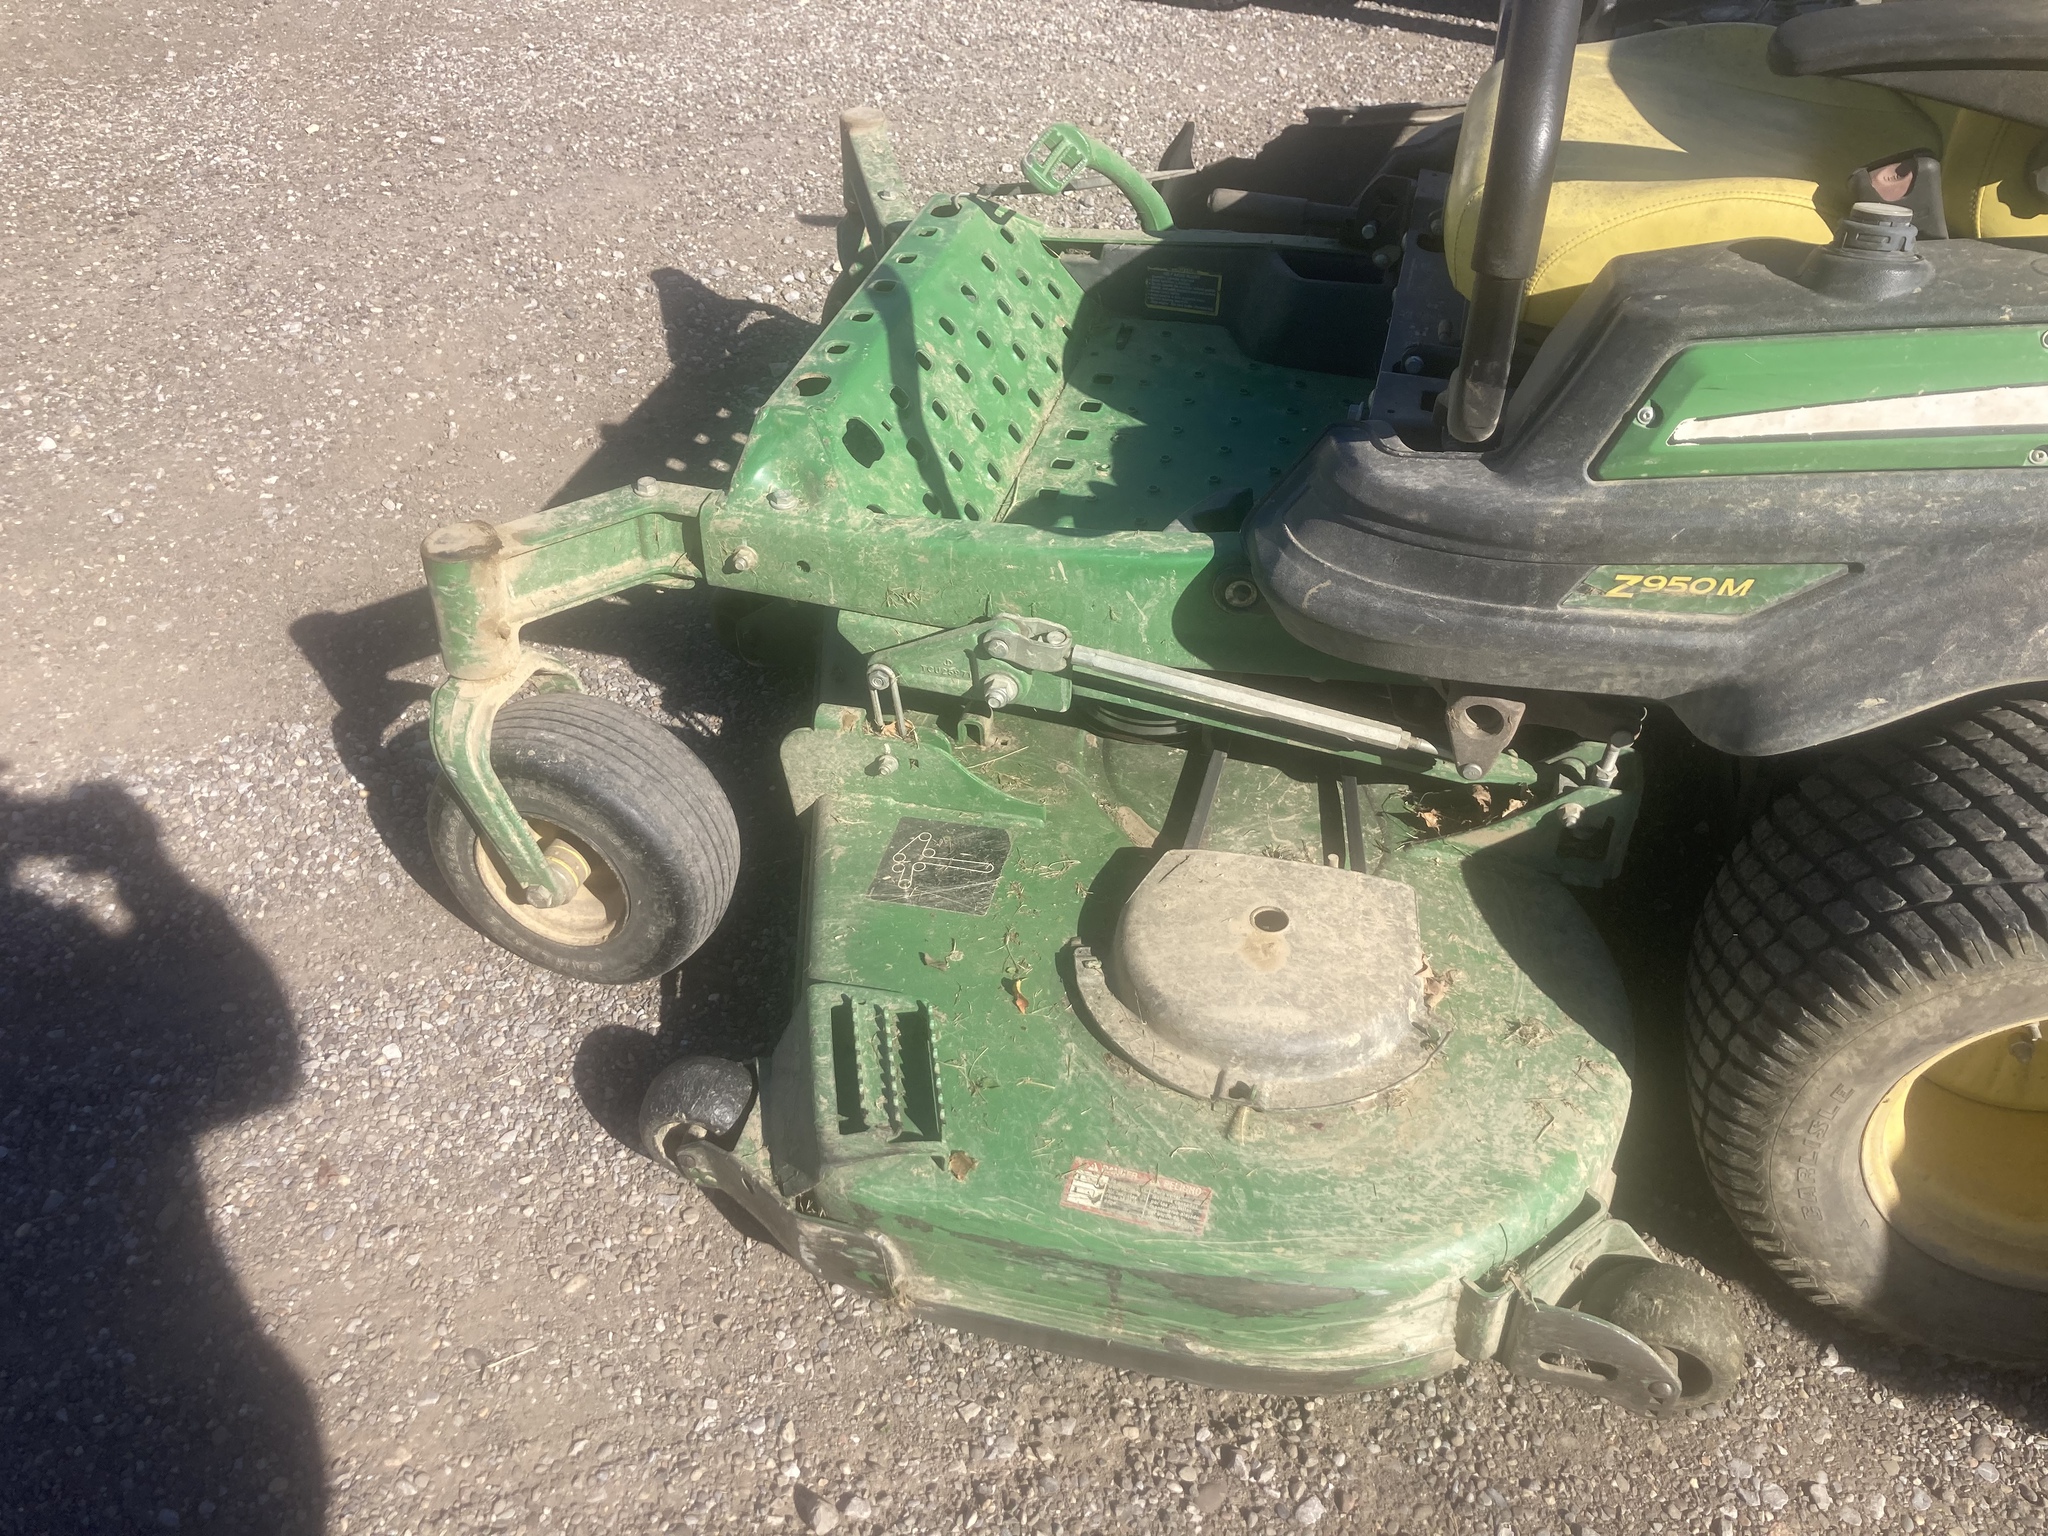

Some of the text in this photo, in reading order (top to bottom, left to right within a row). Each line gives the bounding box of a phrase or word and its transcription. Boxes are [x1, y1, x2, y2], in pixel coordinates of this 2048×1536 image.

[1604, 574, 1755, 598] Z950M
[1796, 1082, 1855, 1222] CARLISLE
[1164, 1179, 1202, 1196] PELIGRO
